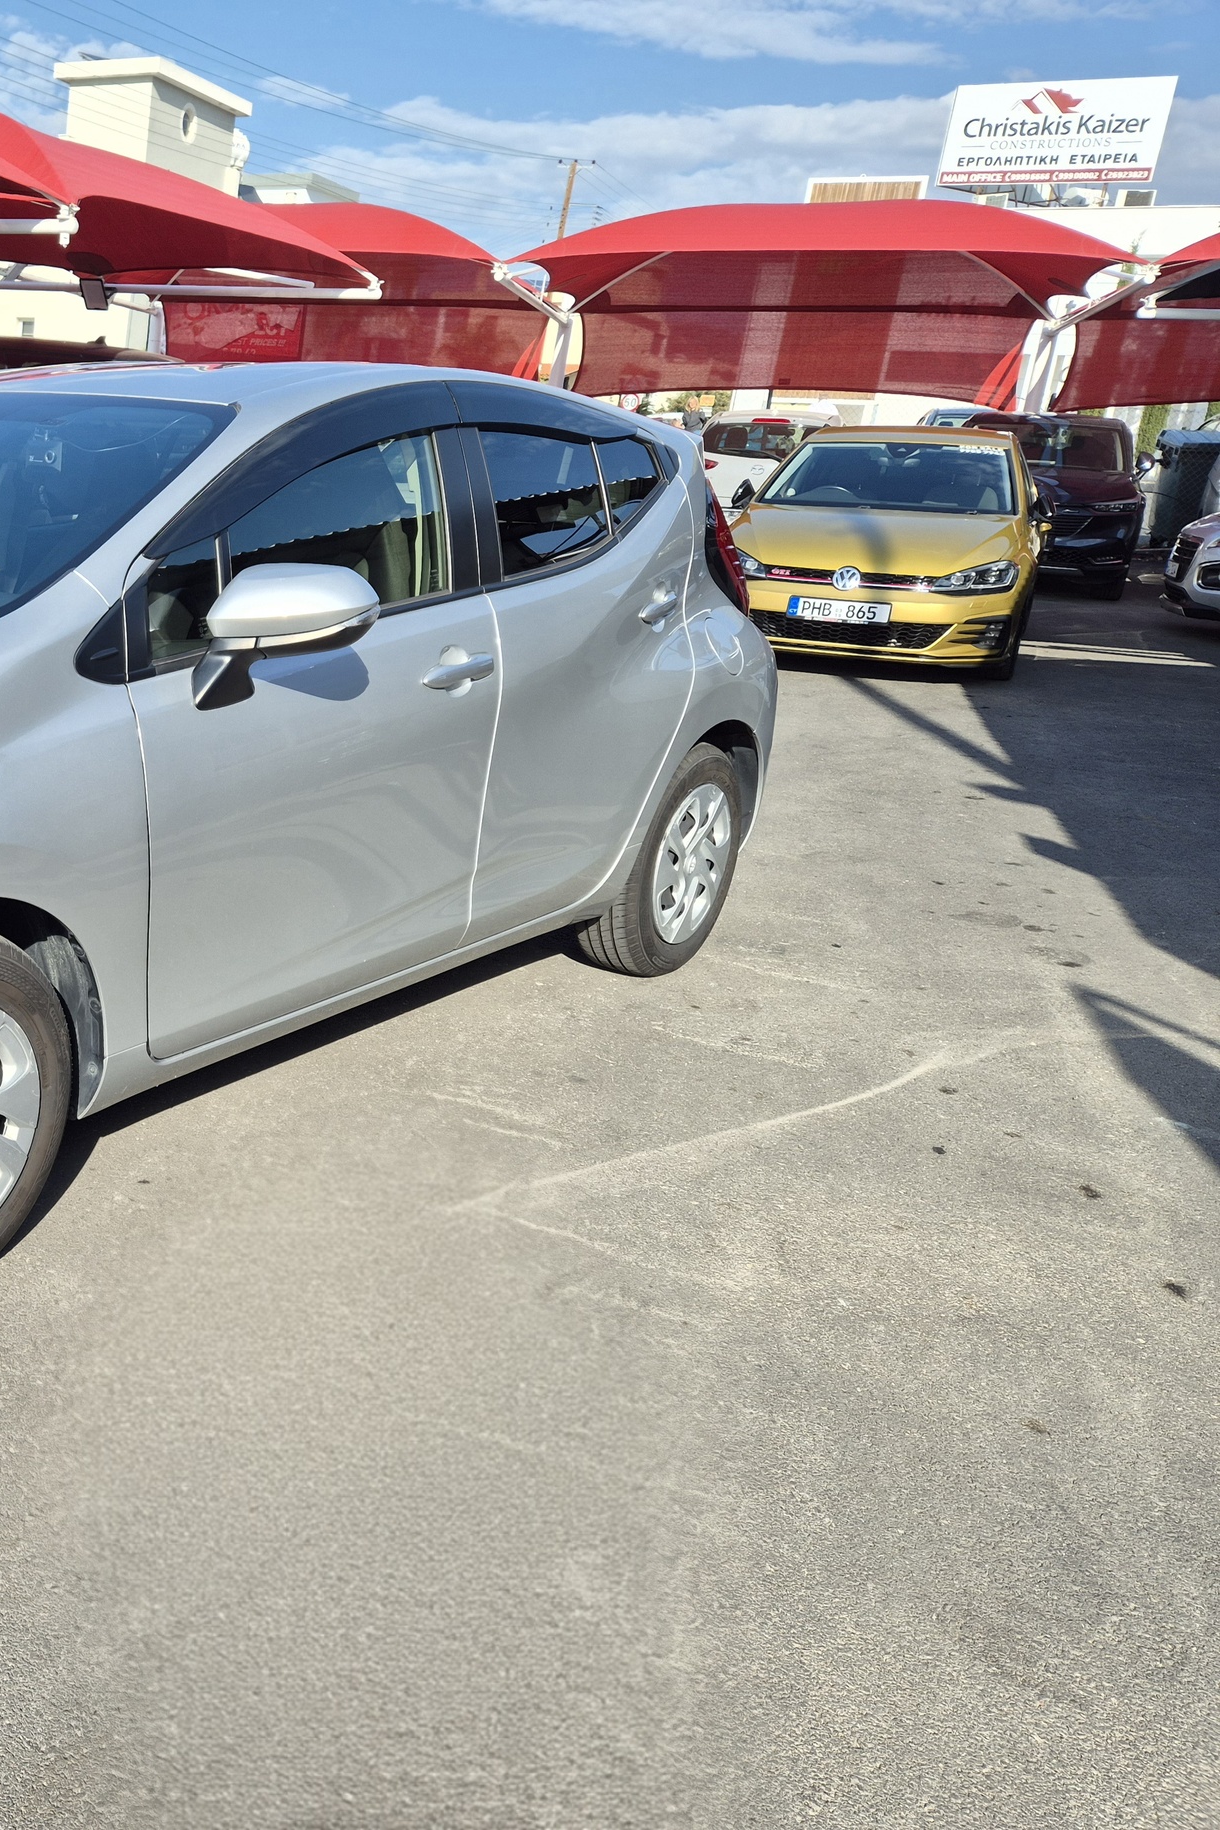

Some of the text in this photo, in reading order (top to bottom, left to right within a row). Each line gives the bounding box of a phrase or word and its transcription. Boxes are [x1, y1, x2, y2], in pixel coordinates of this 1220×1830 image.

[963, 113, 1151, 138] Christakis Kaizer
[989, 137, 1112, 150] CONSTRUCTIONS
[957, 153, 1138, 167] ΕΡΓΟΛΗΠΤΙΚΗ ΕΤΑΙΡΕΙΑ
[942, 173, 968, 183] MAIN
[969, 172, 1004, 182] OFFICE
[625, 397, 637, 408] 50
[801, 600, 878, 620] PHB 865
